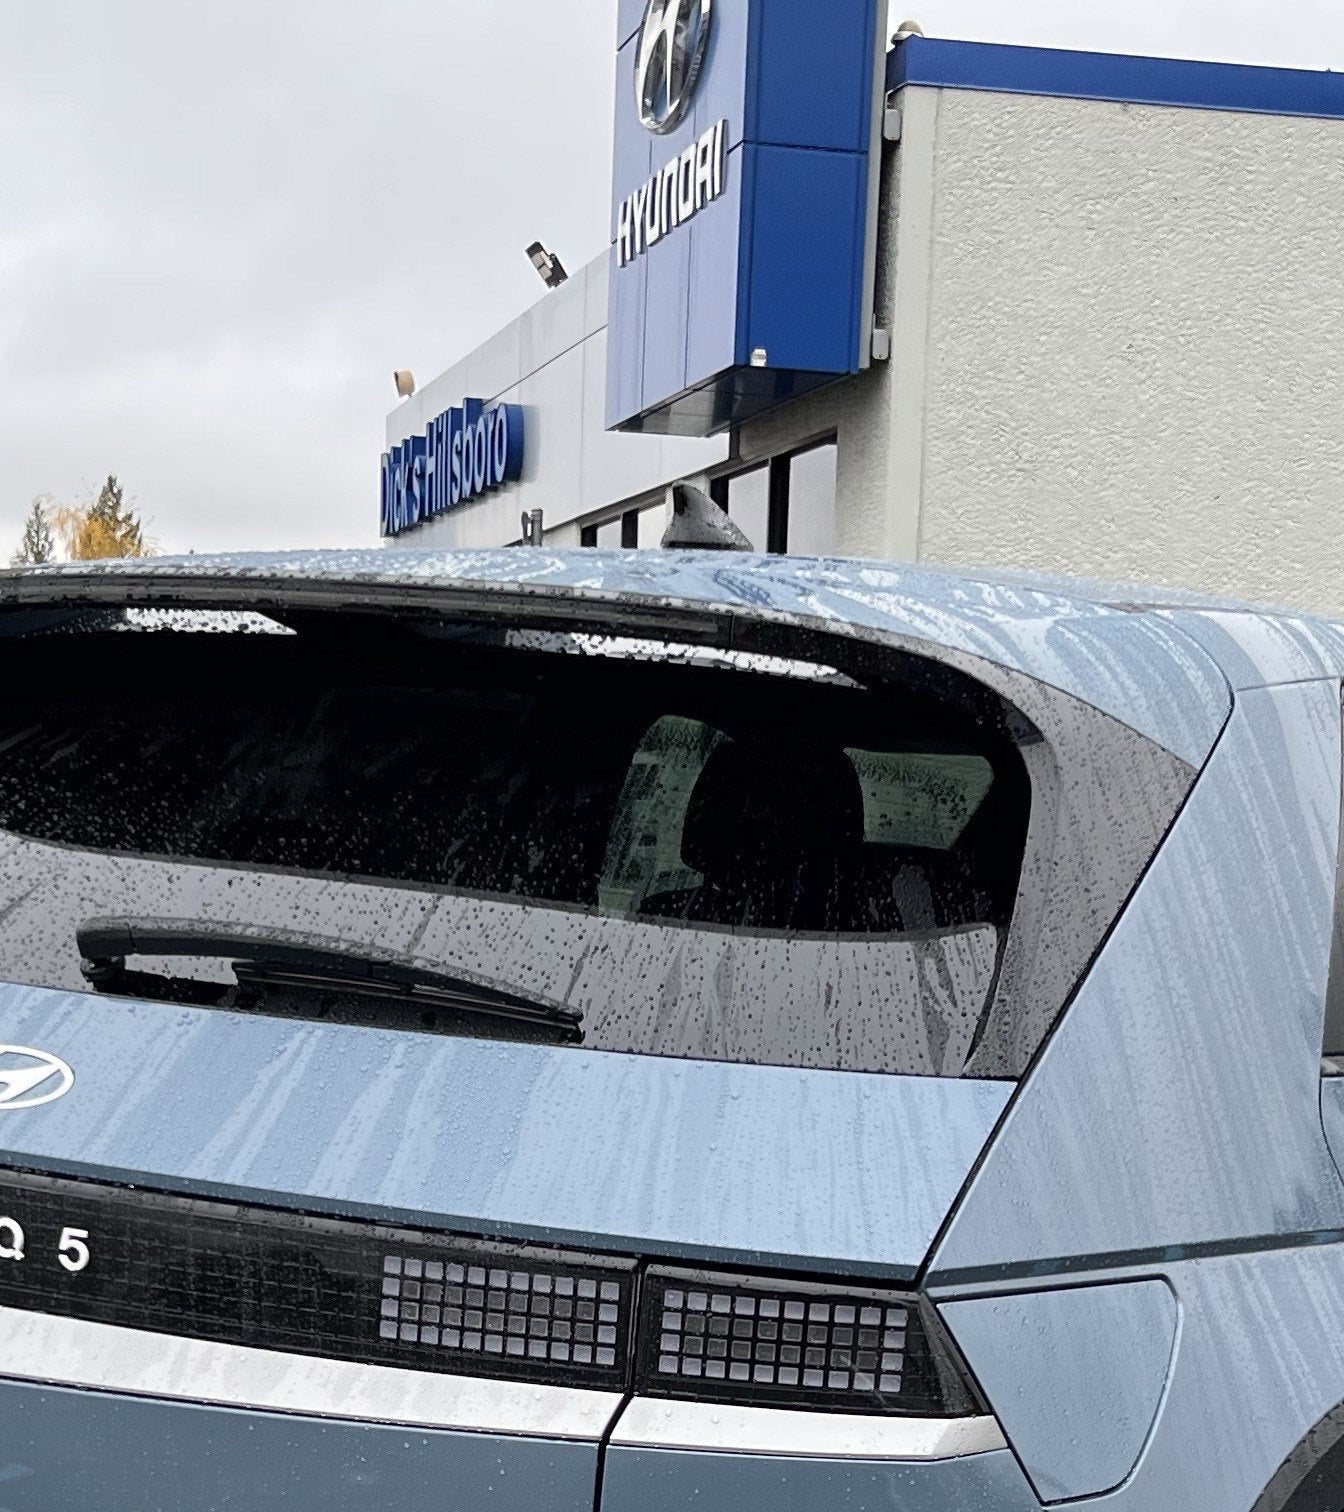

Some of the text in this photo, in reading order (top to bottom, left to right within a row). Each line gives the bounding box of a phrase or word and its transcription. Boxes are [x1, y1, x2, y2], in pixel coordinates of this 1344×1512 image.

[617, 118, 727, 267] HYUNDAI
[380, 397, 511, 537] Dick's Hillsboro
[58, 1227, 91, 1272] 5
